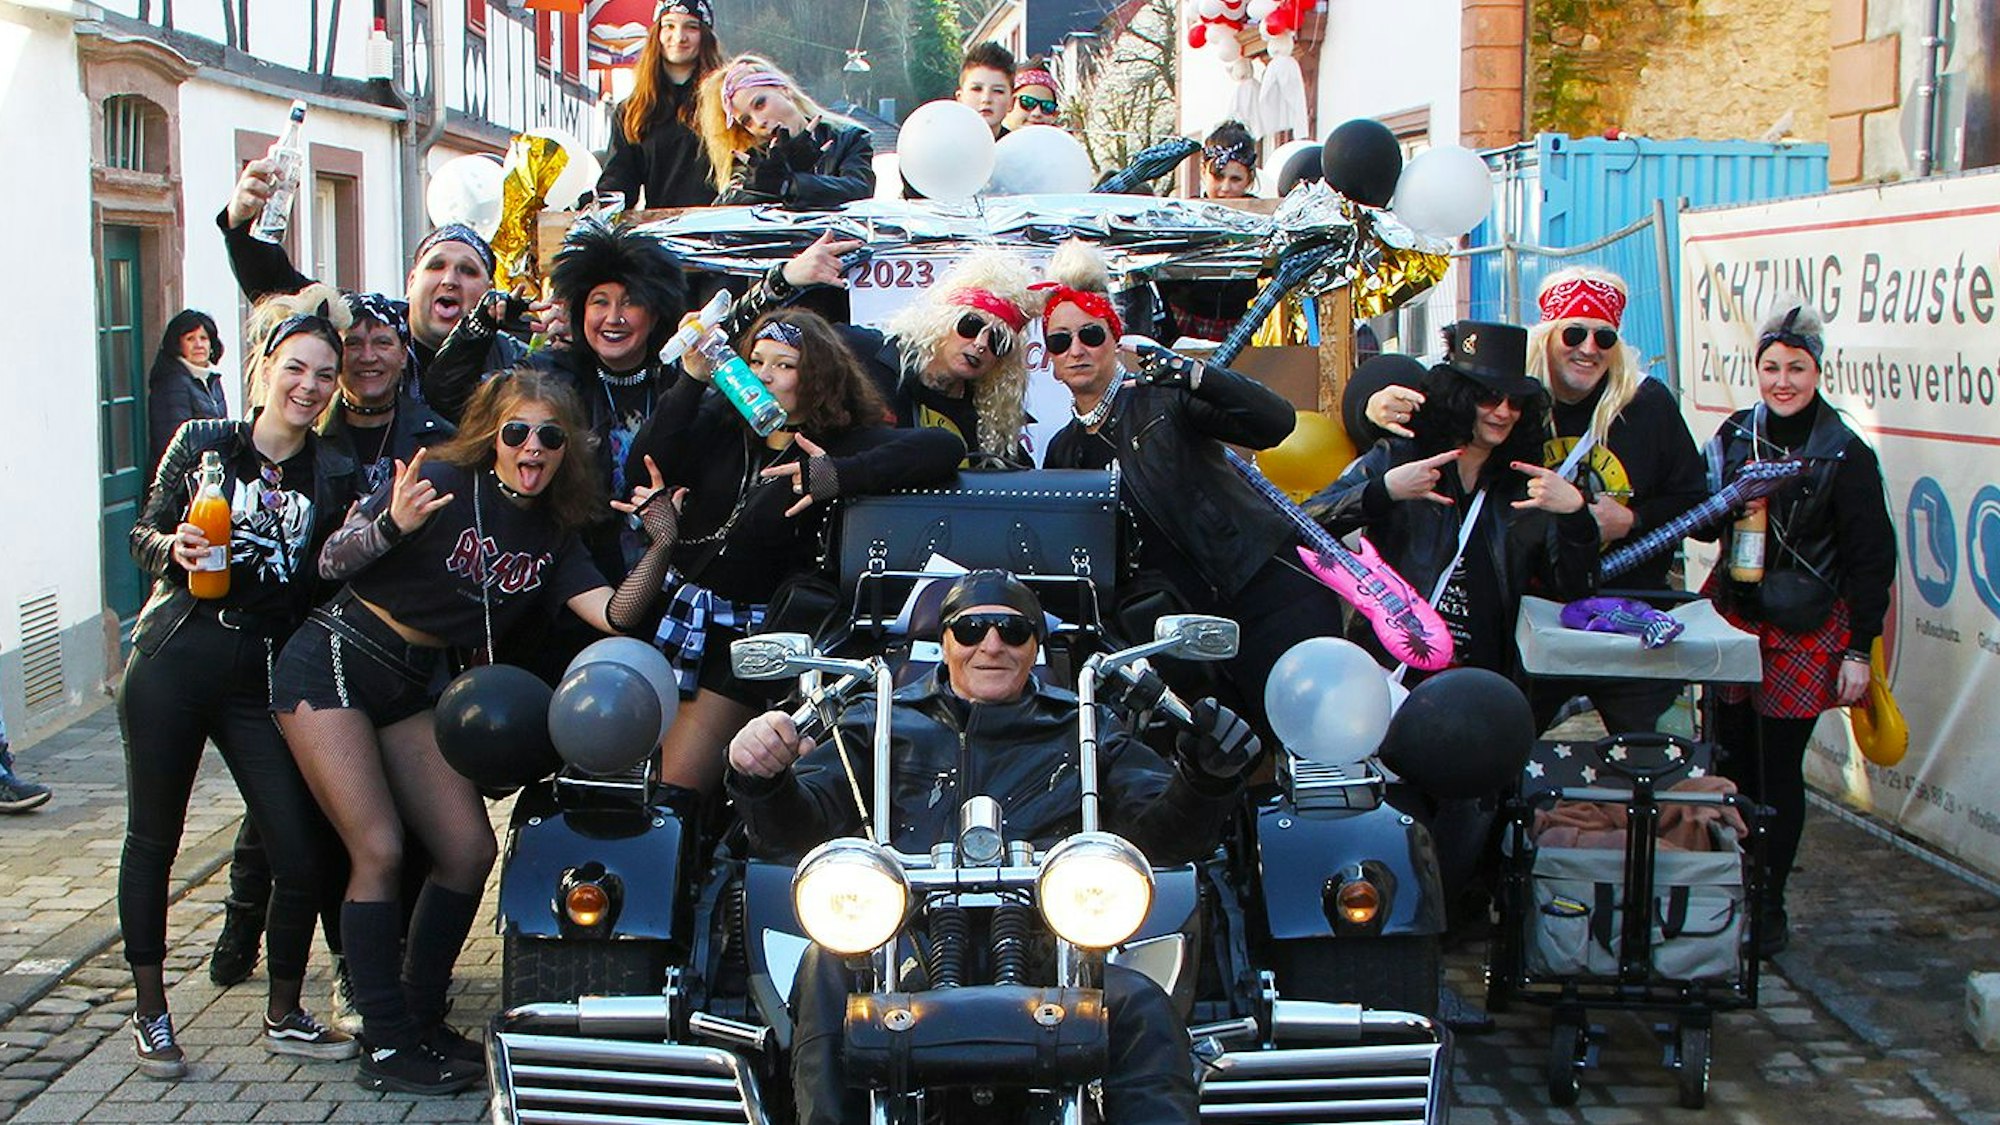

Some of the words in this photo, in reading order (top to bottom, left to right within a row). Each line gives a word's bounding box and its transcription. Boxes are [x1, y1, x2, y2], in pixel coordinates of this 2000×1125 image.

[854, 260, 935, 288] 2023
[1858, 251, 1999, 325] Bauste
[1823, 348, 1901, 409] efugte
